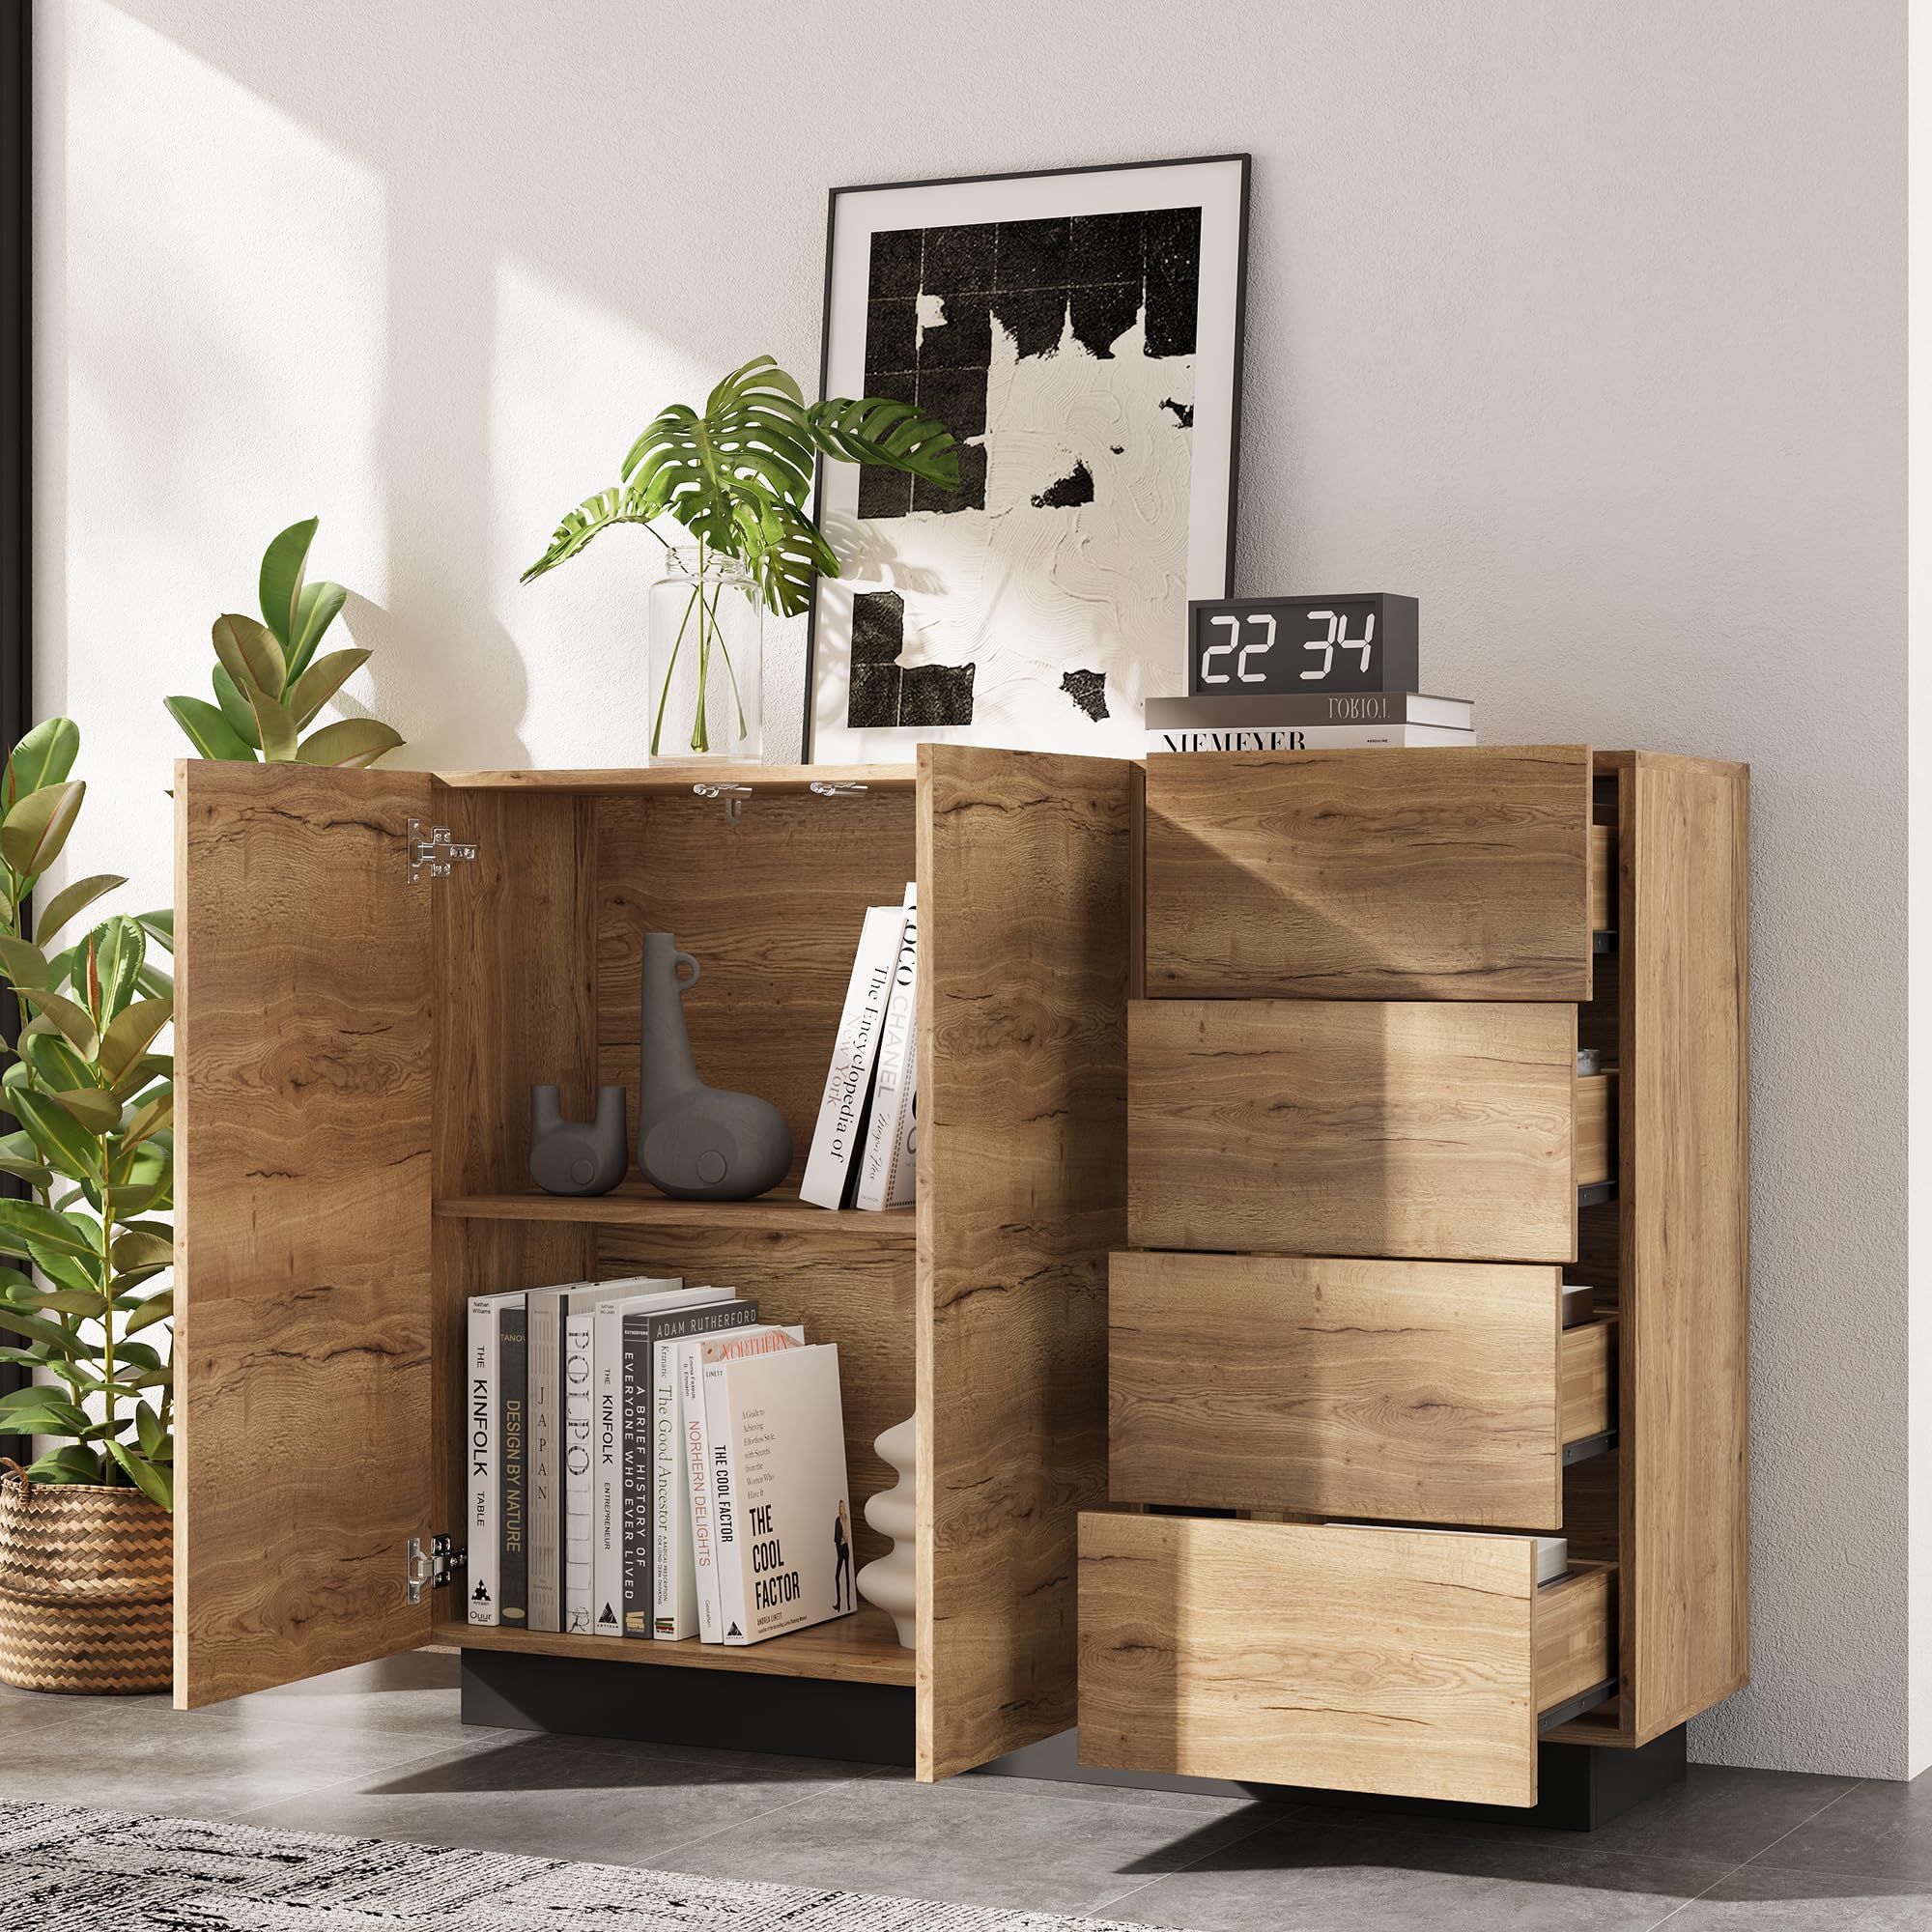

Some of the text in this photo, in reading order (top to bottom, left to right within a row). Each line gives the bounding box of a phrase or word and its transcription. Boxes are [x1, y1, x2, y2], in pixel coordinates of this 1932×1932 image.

[1201, 611, 1376, 684] 22 34
[1162, 731, 1306, 753] NIEMEYER
[827, 1013, 862, 1106] New York
[831, 966, 889, 1163] The Encyclopedia of
[877, 996, 908, 1098] CHANEL
[657, 1309, 756, 1338] ADAM RUTHERFORD
[473, 1379, 488, 1476] KINFOLK
[506, 1400, 521, 1552] DESIGN BY NATURE
[538, 1387, 547, 1499] JAPAN
[603, 1395, 613, 1464] KINFOLK
[624, 1352, 634, 1599] EVERYONE WHO EVER LIVED
[658, 1385, 673, 1531] The Good Ancestor
[637, 1386, 646, 1567] A BRIEF HISTORY OF
[689, 1421, 711, 1567] NORHERN DELIGHTS
[714, 1445, 733, 1543] THE COOL FACTOR
[749, 1504, 773, 1536] THE
[753, 1539, 784, 1574] COOL
[755, 1571, 801, 1610] FACTOR
[469, 1611, 492, 1621] Ouur
